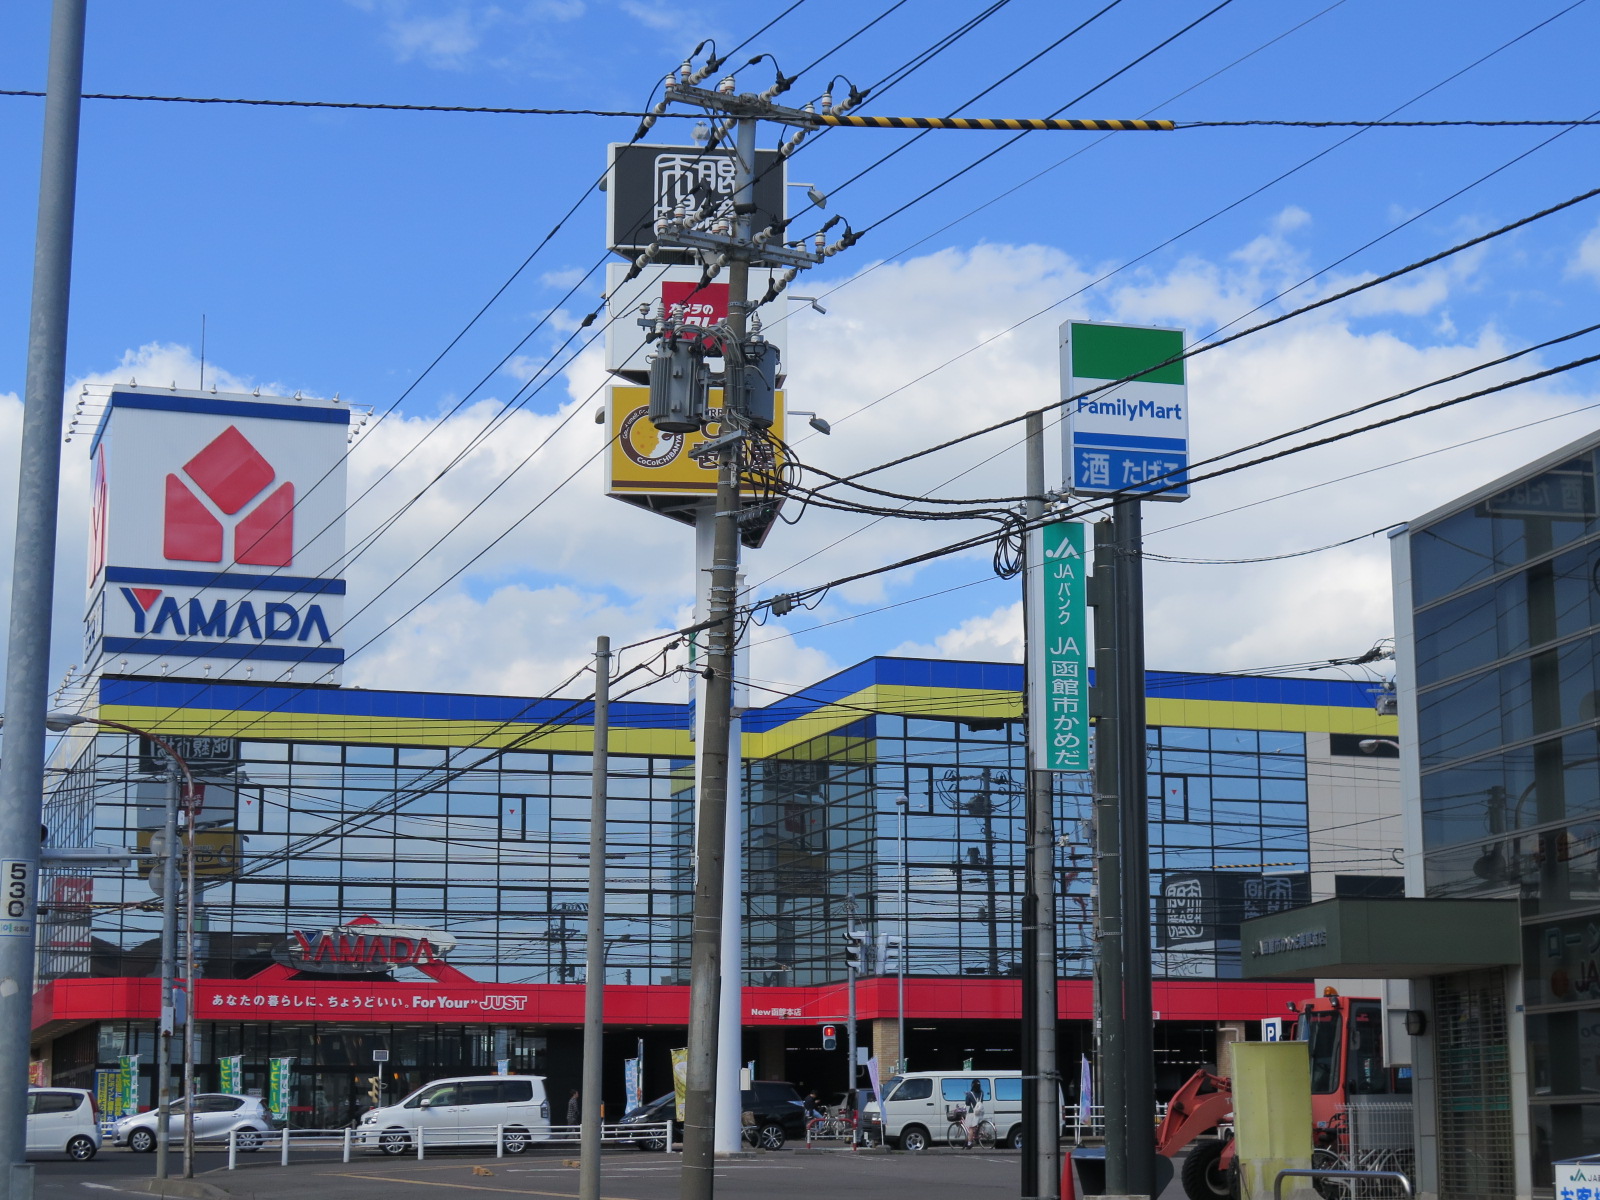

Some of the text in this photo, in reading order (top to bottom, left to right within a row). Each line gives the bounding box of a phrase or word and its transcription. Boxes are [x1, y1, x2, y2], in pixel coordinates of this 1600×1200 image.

[1077, 396, 1182, 422] FamilyMart
[1081, 452, 1180, 486] 酒 たばこ
[1053, 563, 1075, 626] JAバンク
[119, 586, 332, 643] YAMADA
[1050, 636, 1081, 766] JA函館市かめだ
[8, 862, 27, 918] 530
[293, 930, 438, 964] YAMADA
[212, 994, 528, 1011] あなたの暮らしに、ちょうどいい。 For Your JUST
[1266, 1026, 1275, 1042] P
